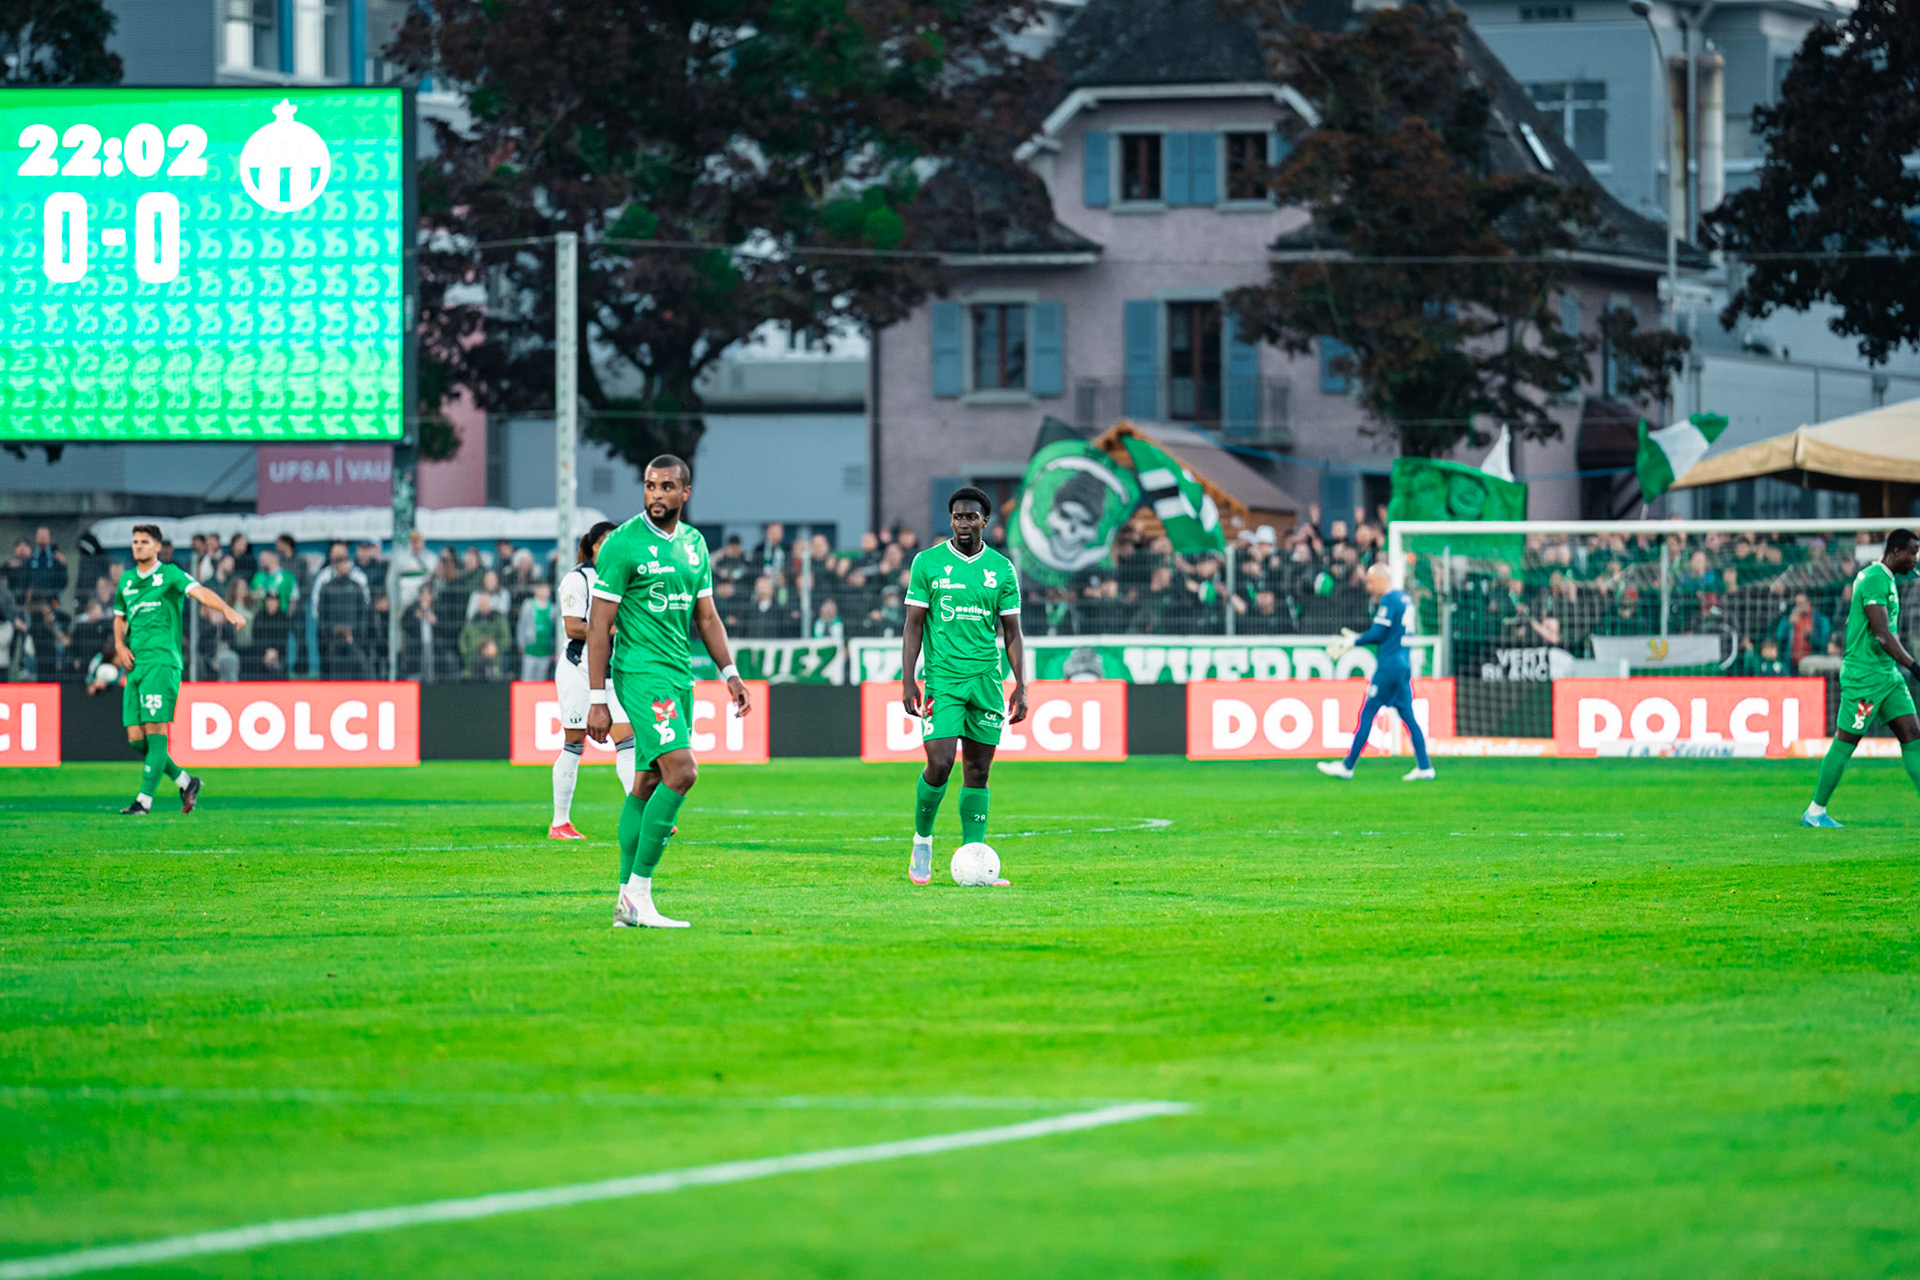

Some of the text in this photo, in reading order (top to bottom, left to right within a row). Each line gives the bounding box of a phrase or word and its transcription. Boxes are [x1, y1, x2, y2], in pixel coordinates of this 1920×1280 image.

[17, 123, 208, 177] 22:02
[1122, 647, 1424, 684] YVERDO
[190, 700, 395, 751] DOLCI
[535, 701, 744, 752] DCI
[886, 699, 1101, 752] DLCI
[1578, 697, 1799, 749] DOLCI
